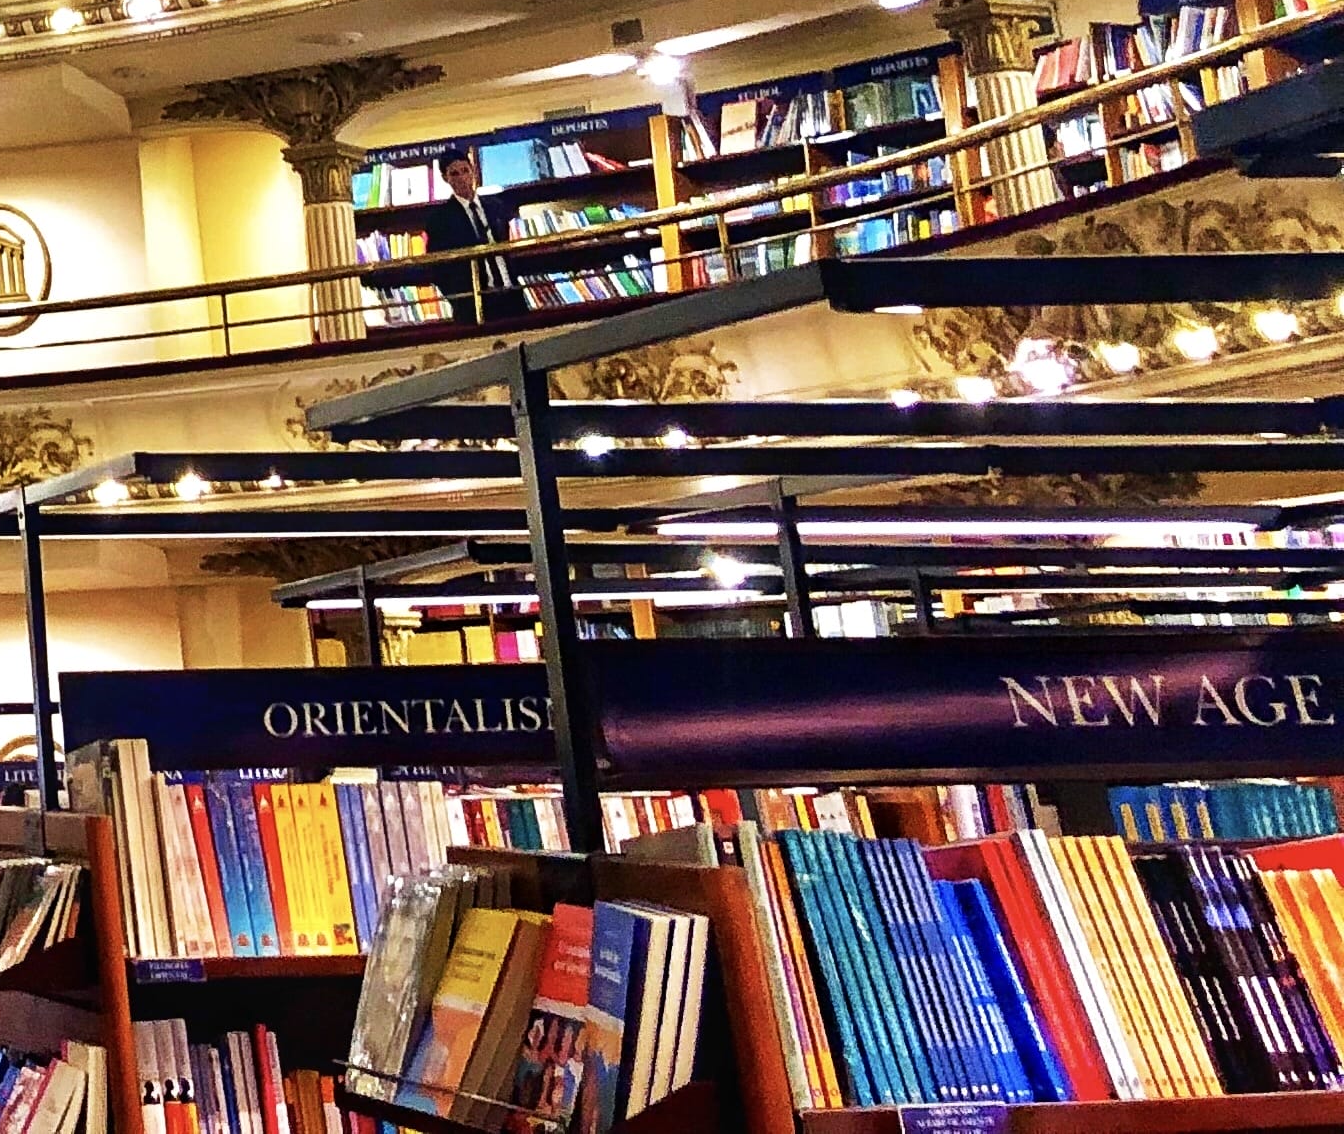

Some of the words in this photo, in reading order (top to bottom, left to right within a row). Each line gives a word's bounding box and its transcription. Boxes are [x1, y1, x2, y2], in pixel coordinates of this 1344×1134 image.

[551, 118, 609, 137] DEPORTES
[999, 674, 1165, 728] NEW
[1193, 674, 1336, 728] AGE
